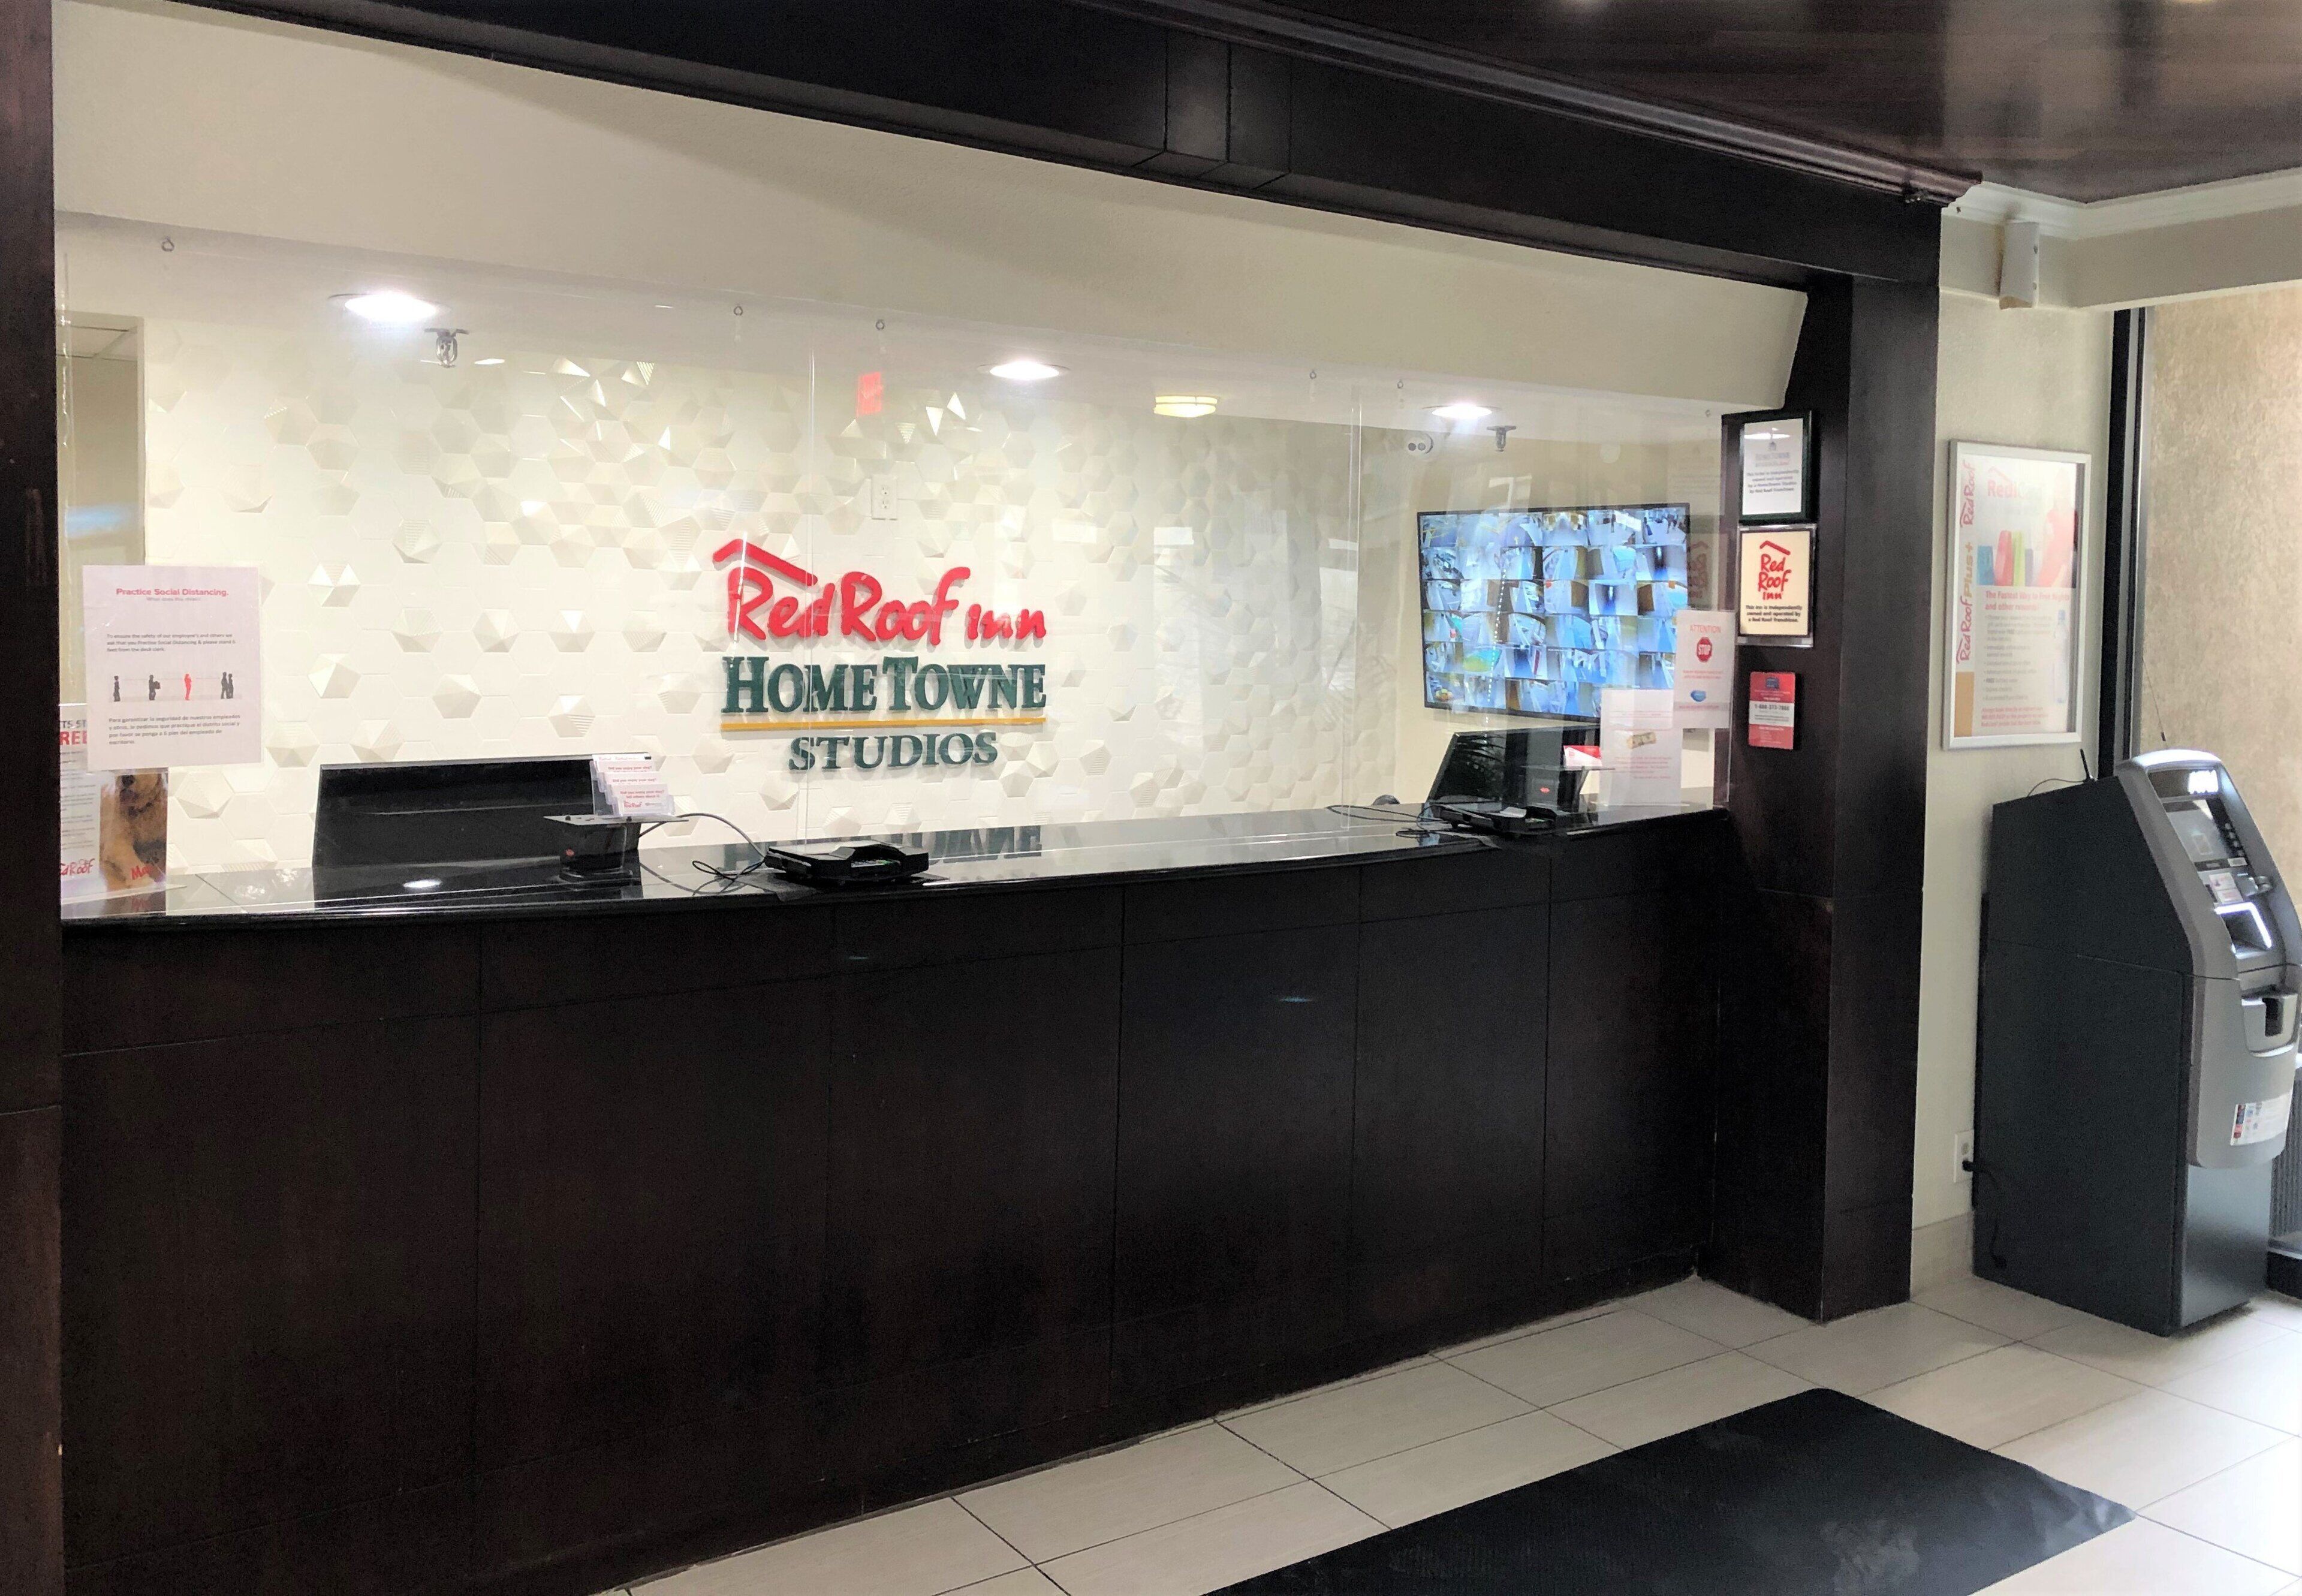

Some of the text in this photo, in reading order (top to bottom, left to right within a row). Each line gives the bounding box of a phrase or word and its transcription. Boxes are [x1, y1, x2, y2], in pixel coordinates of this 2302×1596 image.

[1761, 553, 1786, 573] Red
[1758, 569, 1792, 592] Roof
[182, 588, 228, 597] Distancing.
[727, 567, 835, 640] Red
[840, 567, 971, 646] Roof
[1689, 624, 1722, 634] ATTENTION
[788, 732, 998, 772] STUDIOS
